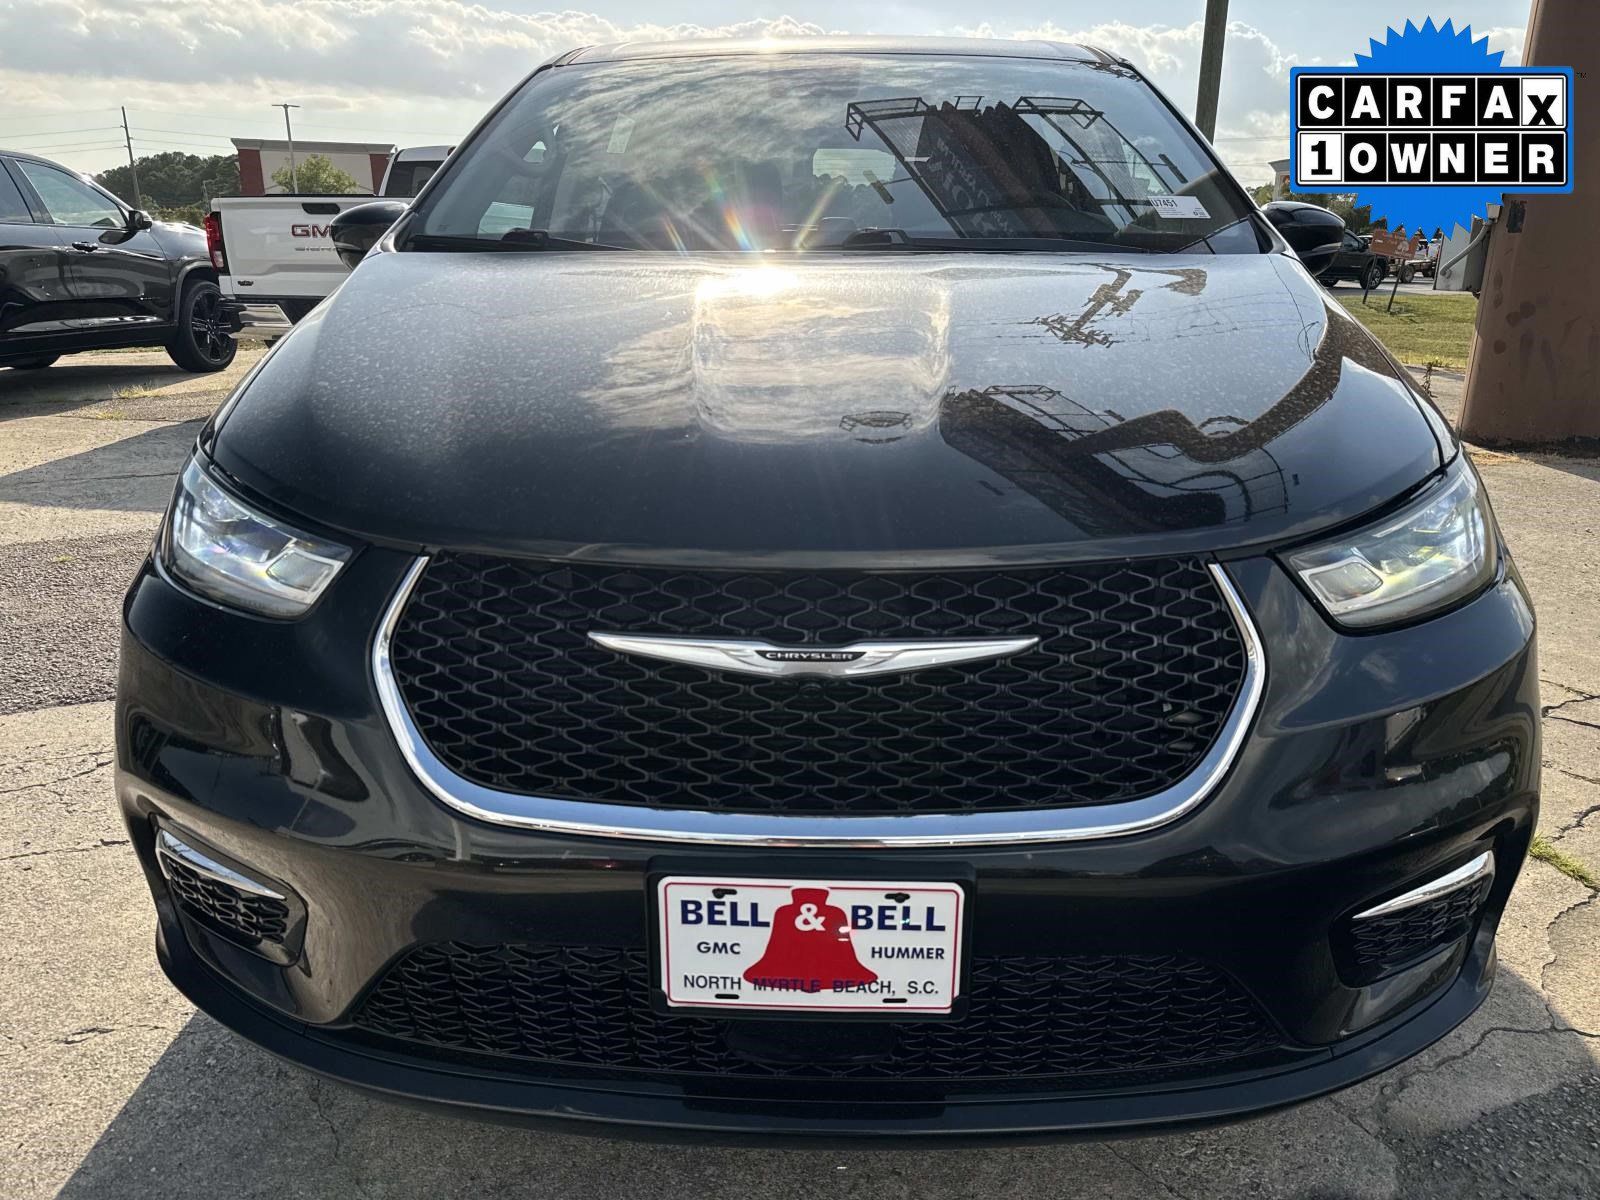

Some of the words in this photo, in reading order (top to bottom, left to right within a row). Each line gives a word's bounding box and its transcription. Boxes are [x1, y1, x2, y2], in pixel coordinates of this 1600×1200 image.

[291, 224, 332, 238] GM
[766, 652, 853, 660] CHRYSLER
[680, 900, 770, 928] BELL
[794, 903, 826, 932] &
[851, 905, 946, 932] BELL
[696, 941, 741, 955] GMC
[871, 946, 945, 960] HUMMER
[683, 974, 742, 991] NORTH
[753, 977, 821, 993] MYRTLE
[832, 980, 896, 996] BEACH,
[907, 980, 939, 995] S.C.
